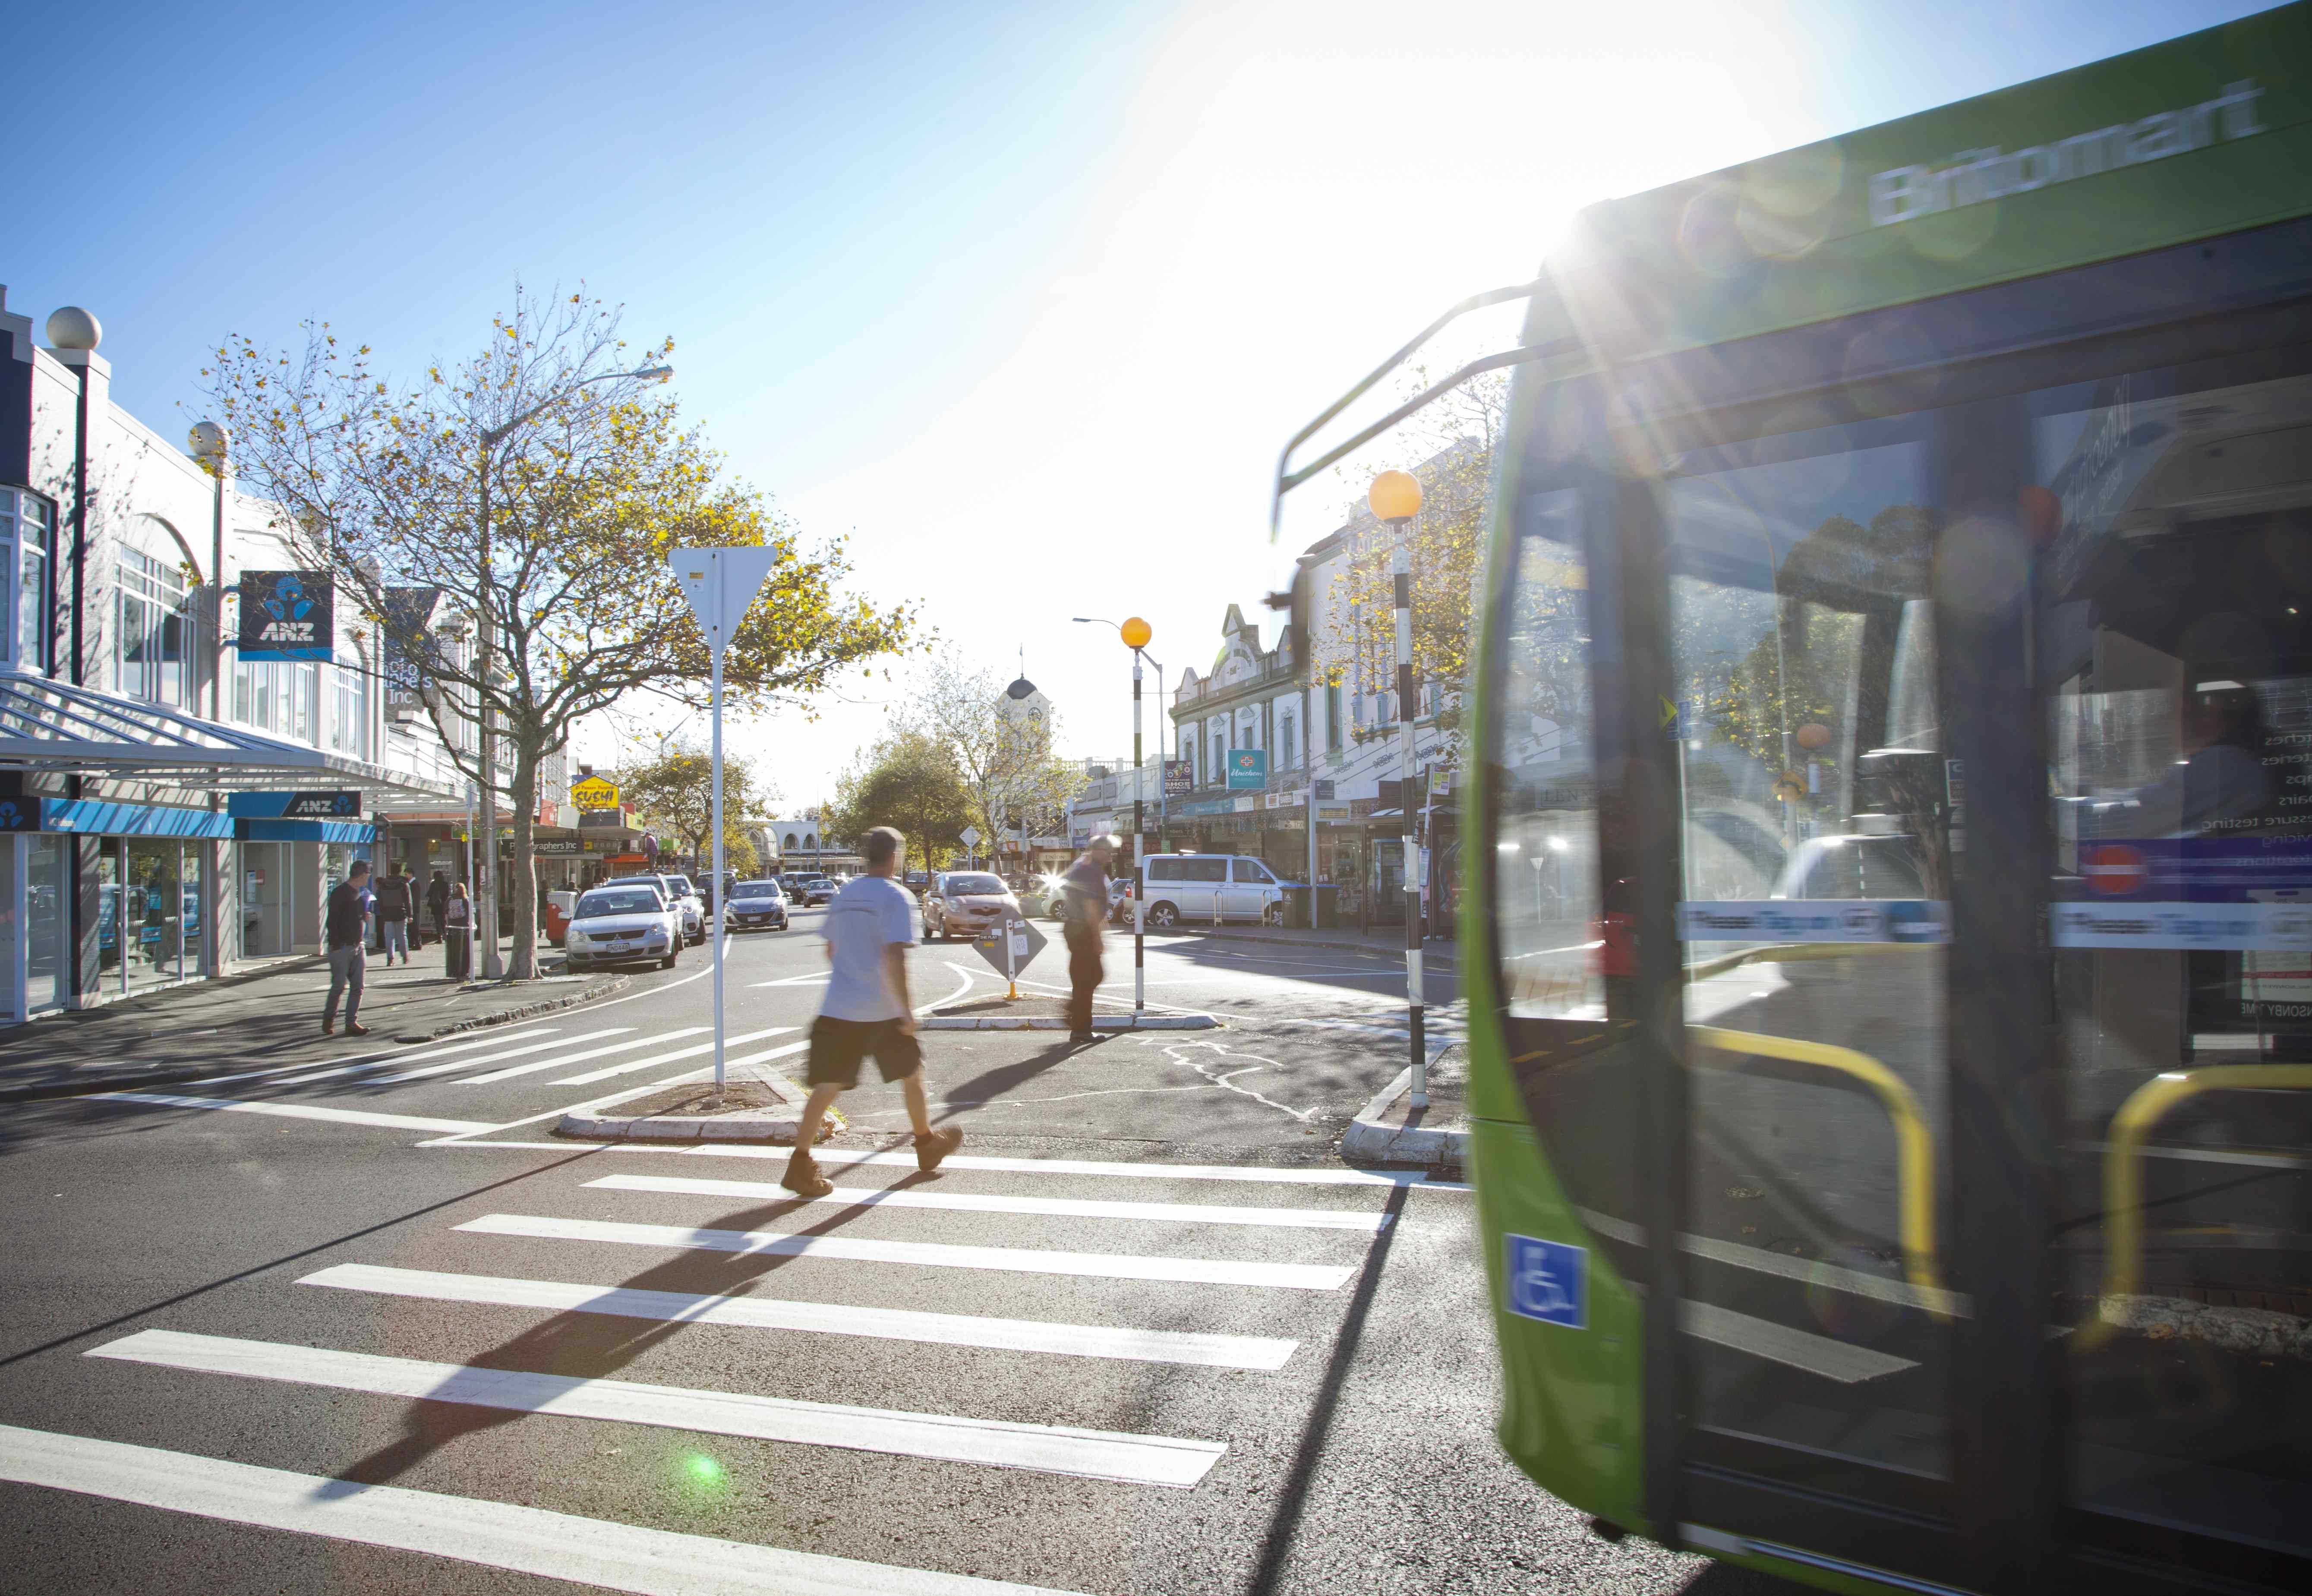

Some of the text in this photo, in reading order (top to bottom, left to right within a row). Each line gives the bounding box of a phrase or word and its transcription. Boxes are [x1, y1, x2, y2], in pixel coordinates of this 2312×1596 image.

[1869, 78, 2268, 227] Britomart
[259, 622, 314, 641] ANZ
[389, 689, 413, 704] Inc
[1230, 768, 1263, 777] Unichem
[576, 791, 613, 802] SUSHI
[296, 800, 331, 812] ANZ
